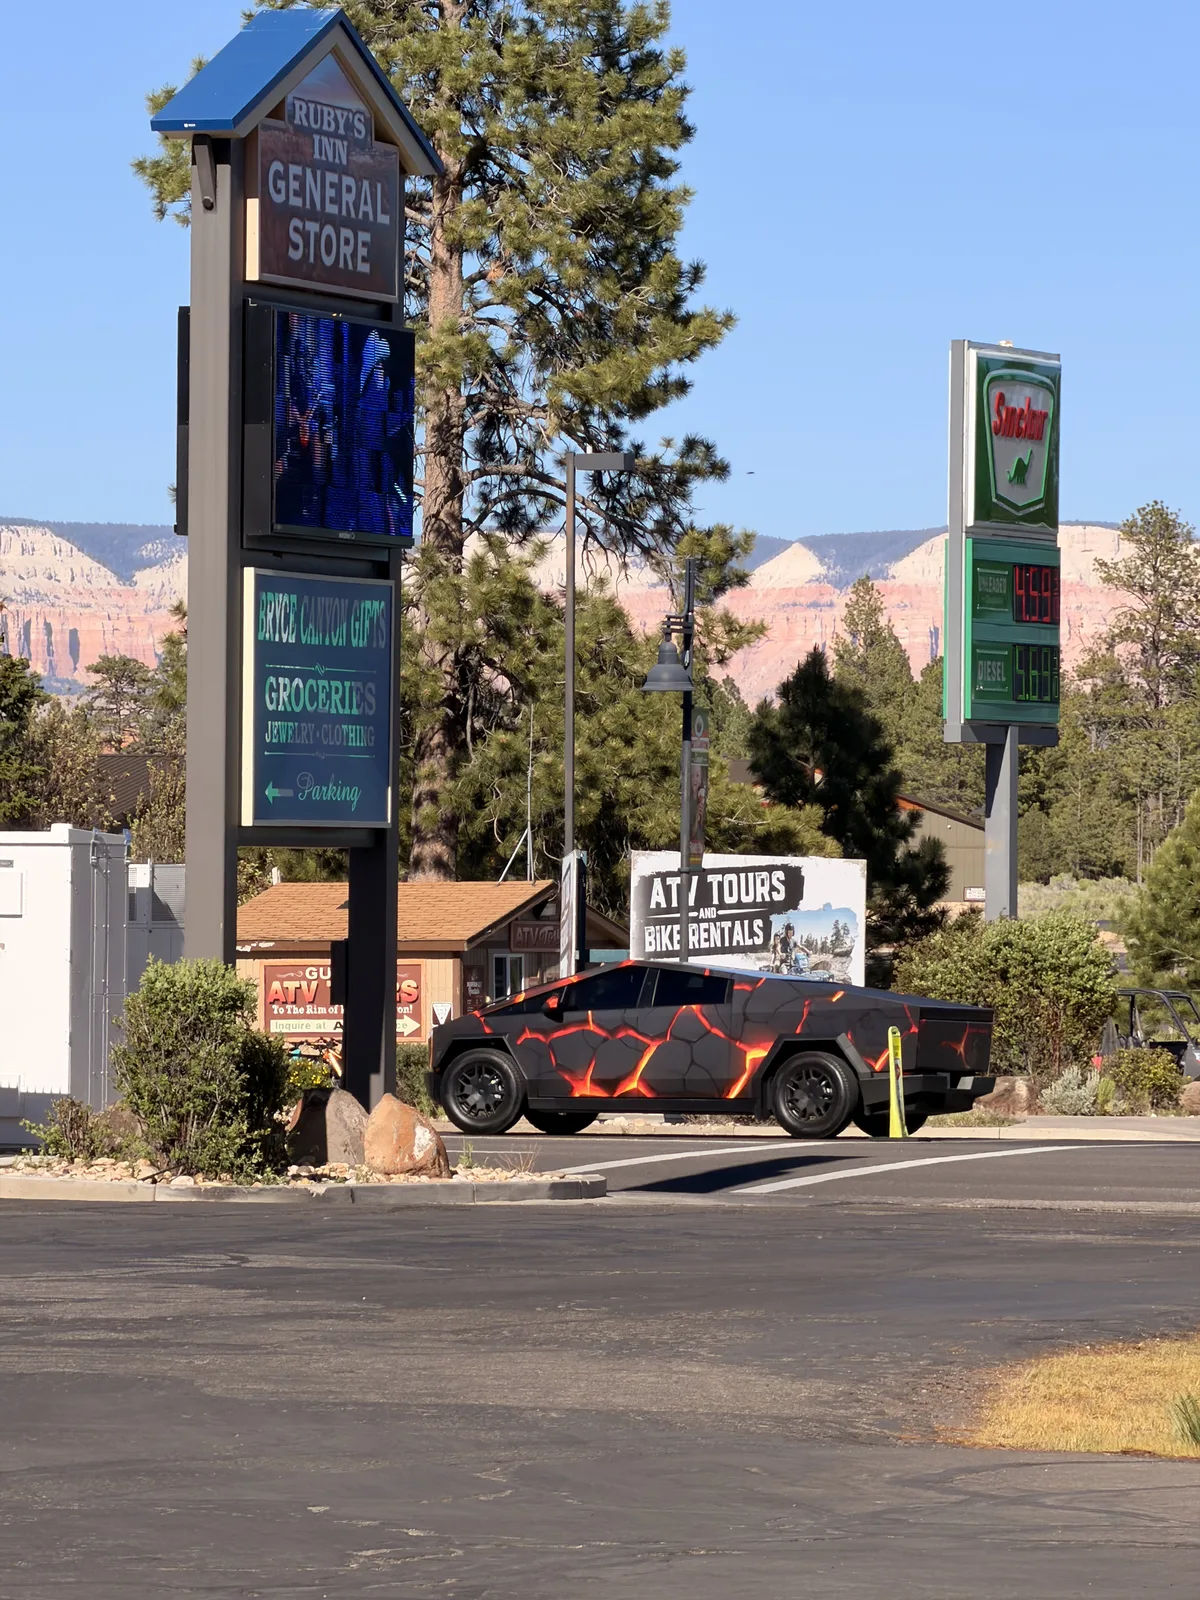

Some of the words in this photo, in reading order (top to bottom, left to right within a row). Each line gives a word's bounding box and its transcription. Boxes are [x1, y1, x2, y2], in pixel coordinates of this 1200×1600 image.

[293, 98, 366, 139] RUBY'S
[313, 134, 348, 165] INN
[268, 160, 390, 225] GENERAL
[288, 217, 371, 274] STORE
[992, 391, 1048, 441] Sinclair
[258, 591, 297, 643] BRYCE
[301, 595, 348, 647] CANYON
[351, 599, 387, 649] GIFTS
[978, 660, 1006, 682] DIESEL
[265, 676, 376, 716] GROCERIES
[265, 721, 315, 744] JEWELRY
[321, 724, 375, 747] CLOTHING
[297, 772, 362, 811] Parking
[707, 870, 785, 905] TOURS
[699, 907, 716, 919] AND
[644, 924, 681, 952] BIKE
[688, 919, 764, 949] RENTALS
[267, 980, 318, 1004] ATV
[272, 1004, 284, 1014] To
[286, 1004, 305, 1014] The
[306, 1004, 327, 1014] Rim
[328, 1004, 339, 1014] of
[275, 1021, 311, 1031] Inquire
[316, 1021, 327, 1030] at
